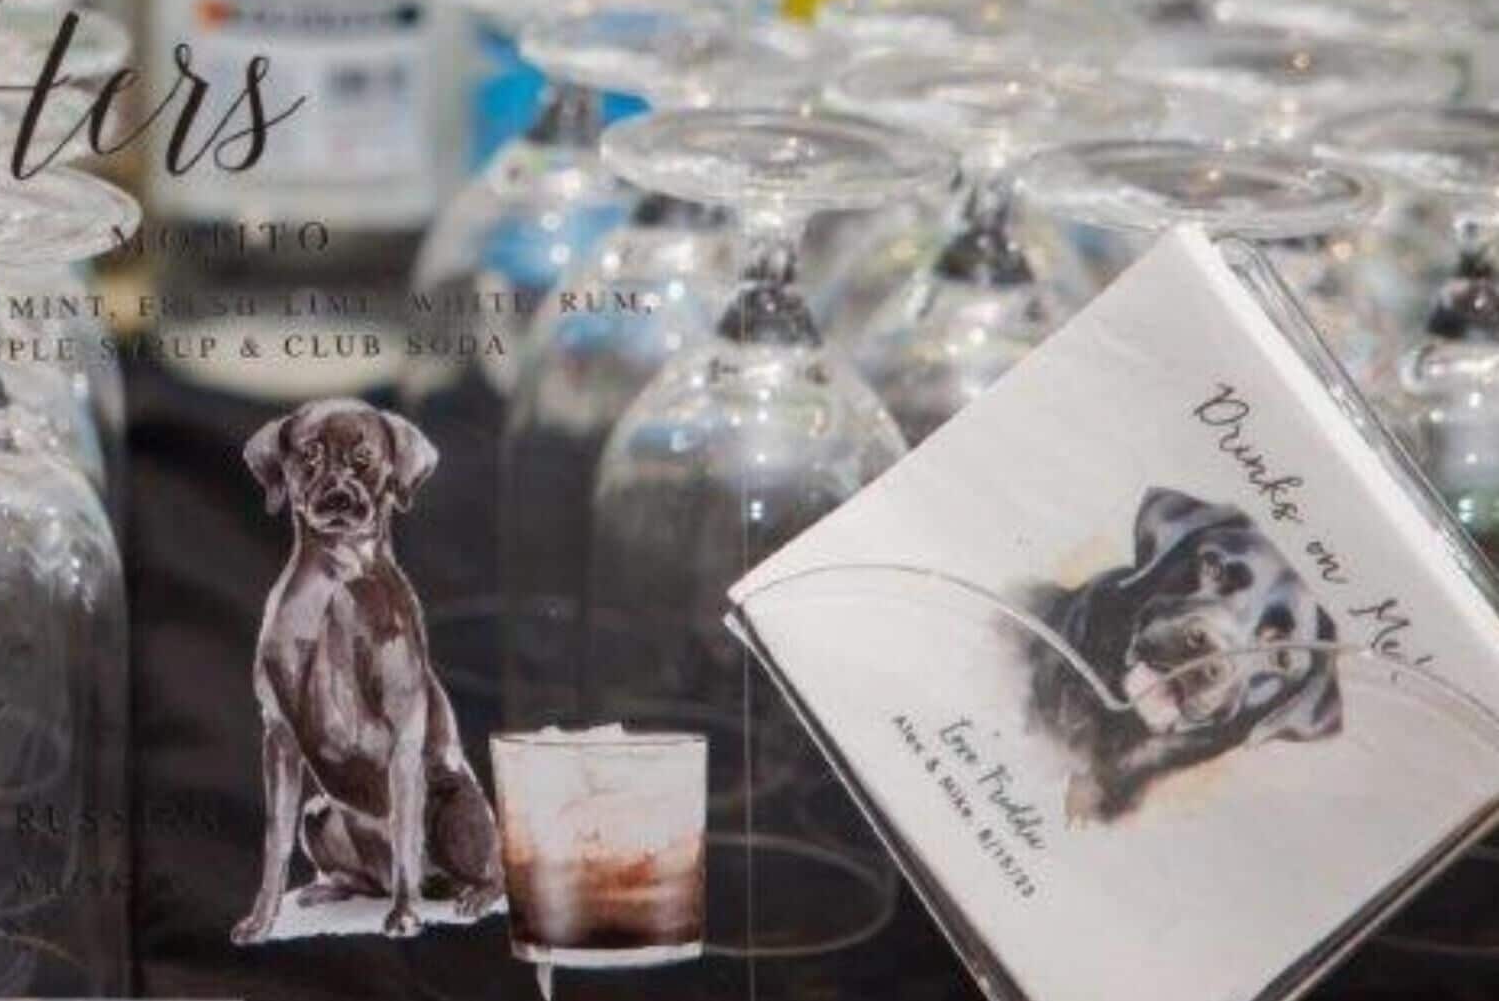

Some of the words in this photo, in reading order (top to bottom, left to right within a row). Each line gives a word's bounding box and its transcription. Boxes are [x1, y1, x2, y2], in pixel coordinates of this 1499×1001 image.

[9, 296, 118, 320] MINT,
[560, 291, 653, 316] RUM,
[240, 336, 262, 358] &
[284, 334, 382, 358] CLUB
[405, 332, 506, 357] SODA
[1193, 383, 1303, 522] Drinks
[1305, 540, 1351, 584] on
